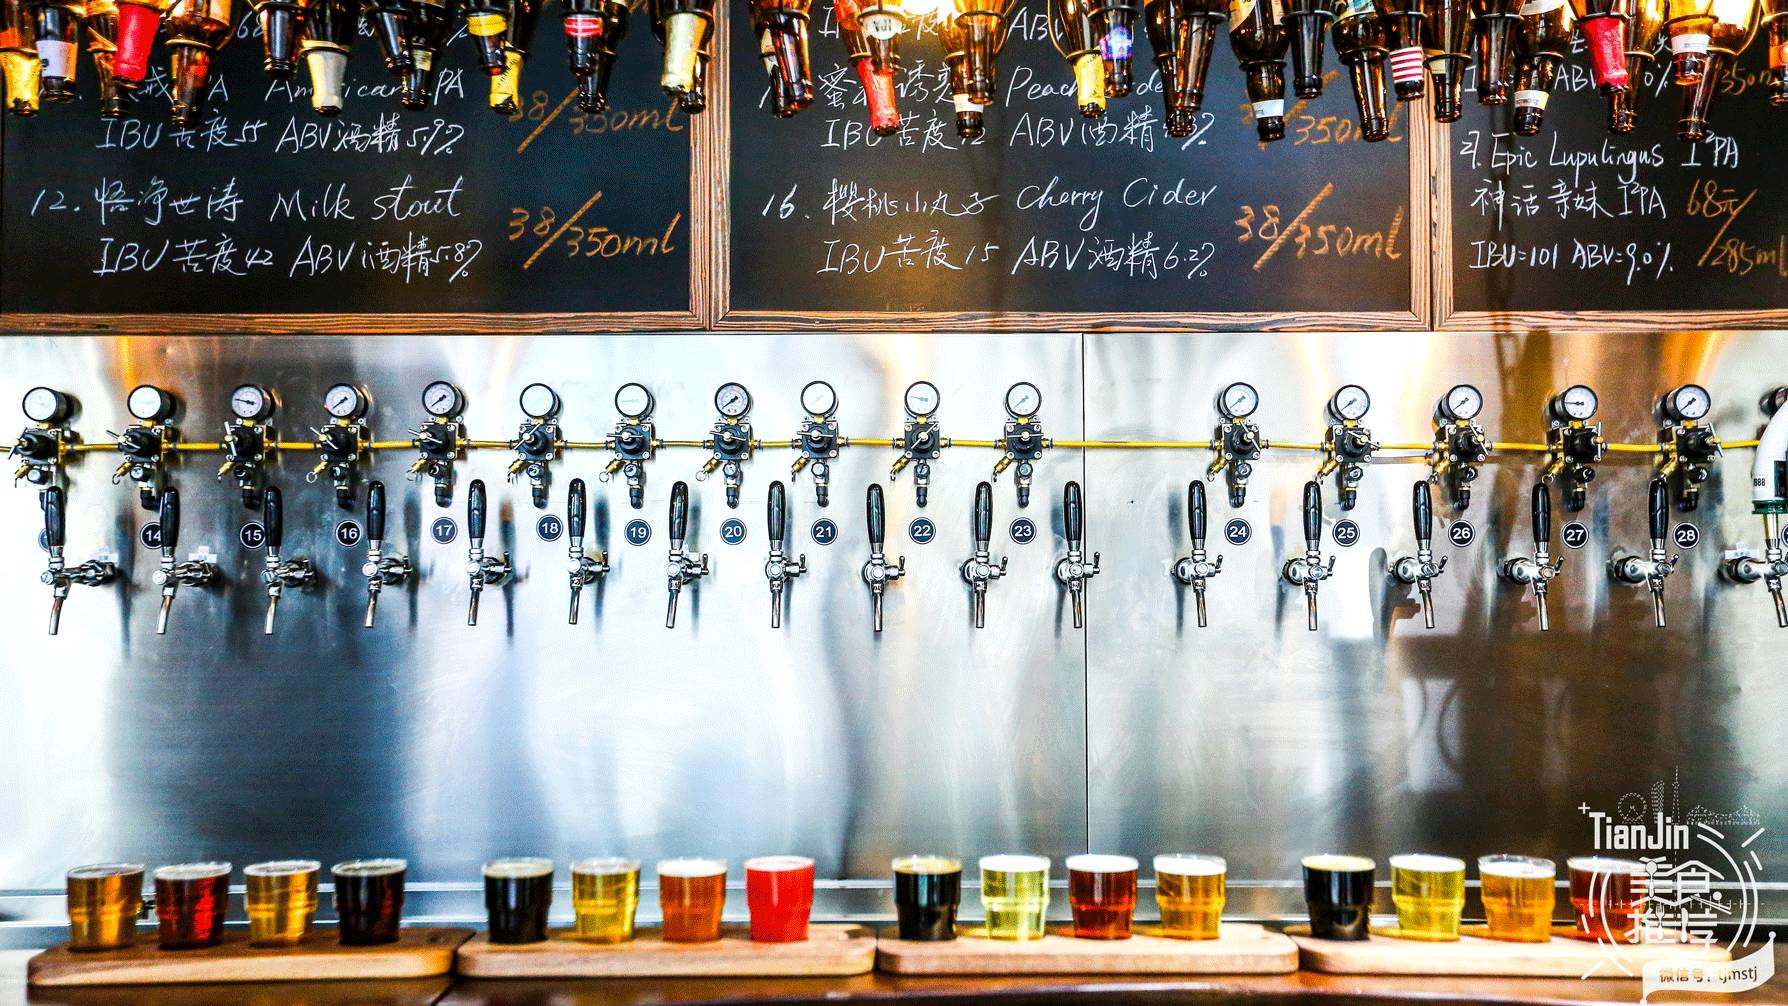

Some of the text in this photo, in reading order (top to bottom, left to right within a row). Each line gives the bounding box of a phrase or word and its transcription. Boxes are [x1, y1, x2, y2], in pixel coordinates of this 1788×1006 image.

[264, 79, 402, 103] Amican
[427, 68, 464, 106] PA
[1491, 132, 1538, 176] Epic
[1549, 131, 1665, 185] Lupulingus
[1123, 177, 1217, 208] Cider
[270, 183, 355, 222] Milk
[145, 528, 161, 542] 14
[244, 528, 262, 542] 15
[340, 526, 358, 540] 16
[436, 524, 452, 537] 17
[541, 522, 559, 535] 18
[629, 526, 647, 540] 19
[724, 525, 742, 538] 20
[815, 525, 832, 538] 21
[913, 523, 931, 538] 22
[1014, 524, 1032, 538] 23
[1229, 525, 1247, 538] 24
[1337, 526, 1355, 540] 25
[1452, 526, 1471, 540] 26
[1566, 529, 1584, 543] 27
[1677, 529, 1695, 543] 28
